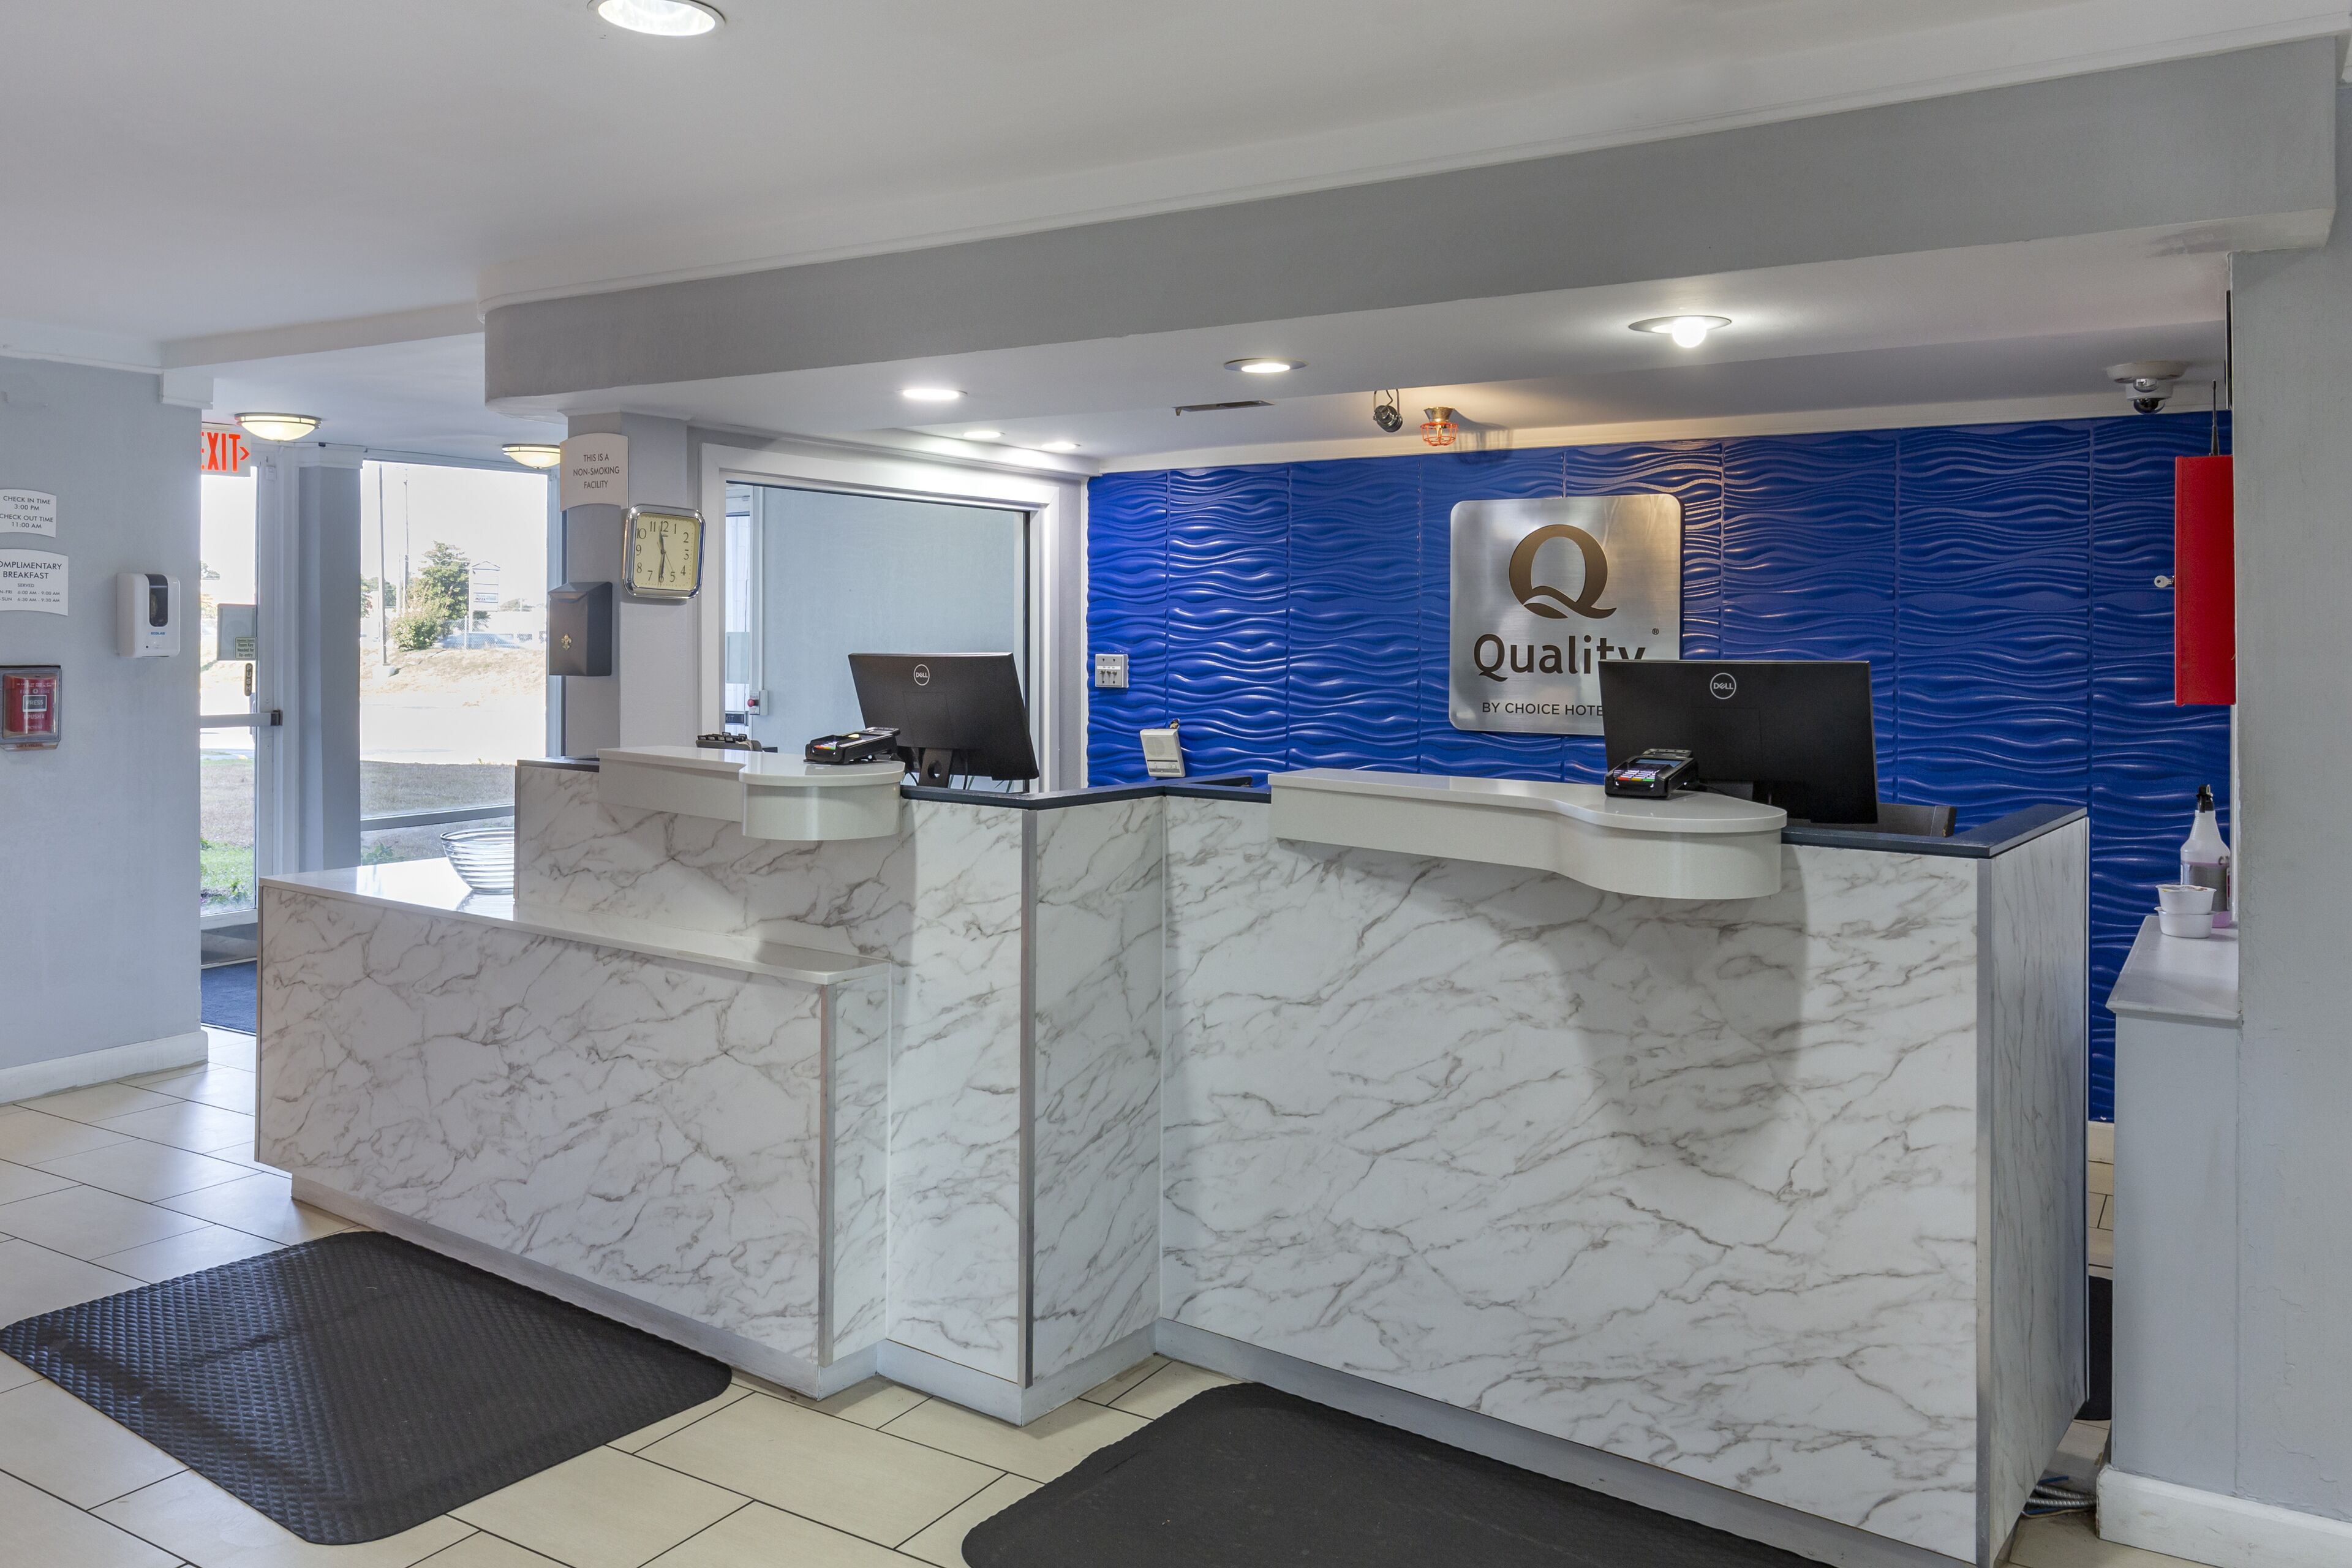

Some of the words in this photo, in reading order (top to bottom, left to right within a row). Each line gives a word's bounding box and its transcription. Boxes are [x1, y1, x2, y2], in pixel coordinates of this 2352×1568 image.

[573, 466, 620, 476] NON-SMOKING
[584, 480, 608, 489] FACILITY
[650, 521, 656, 532] 11
[661, 521, 669, 532] 12
[674, 523, 677, 534] 1
[637, 528, 647, 539] 10
[683, 532, 689, 543] 2
[636, 545, 642, 556] 9
[637, 562, 643, 573] 8
[680, 565, 687, 576] 4
[647, 570, 653, 581] 7
[669, 571, 676, 582] 5
[1482, 702, 1500, 713] BY
[1505, 702, 1559, 715] CHOICE
[1565, 704, 1603, 716] HOTE
